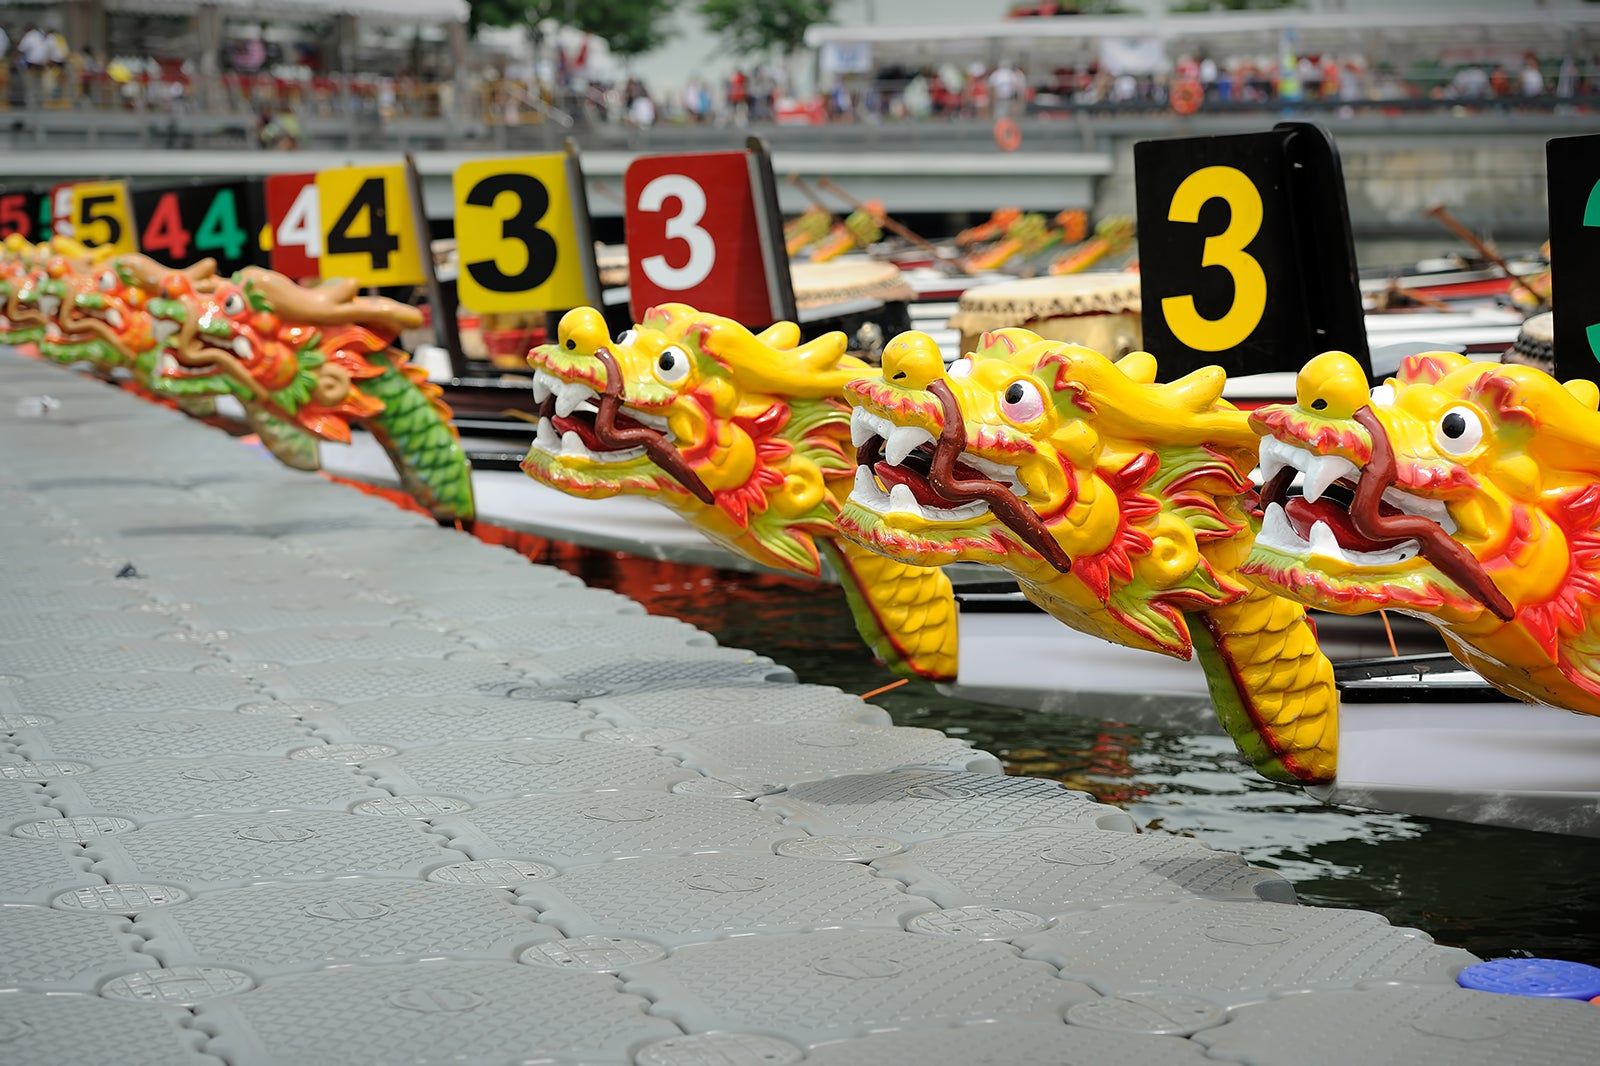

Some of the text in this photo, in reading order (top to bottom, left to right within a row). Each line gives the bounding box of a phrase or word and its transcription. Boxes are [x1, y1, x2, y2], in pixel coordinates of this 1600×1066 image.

[0, 194, 30, 239] 5
[81, 195, 121, 248] 5
[142, 191, 191, 259] 4
[194, 188, 247, 259] 4
[276, 184, 322, 258] 4
[327, 178, 399, 269] 4
[466, 173, 557, 292] 3
[637, 174, 716, 291] 3
[1161, 165, 1268, 351] 3
